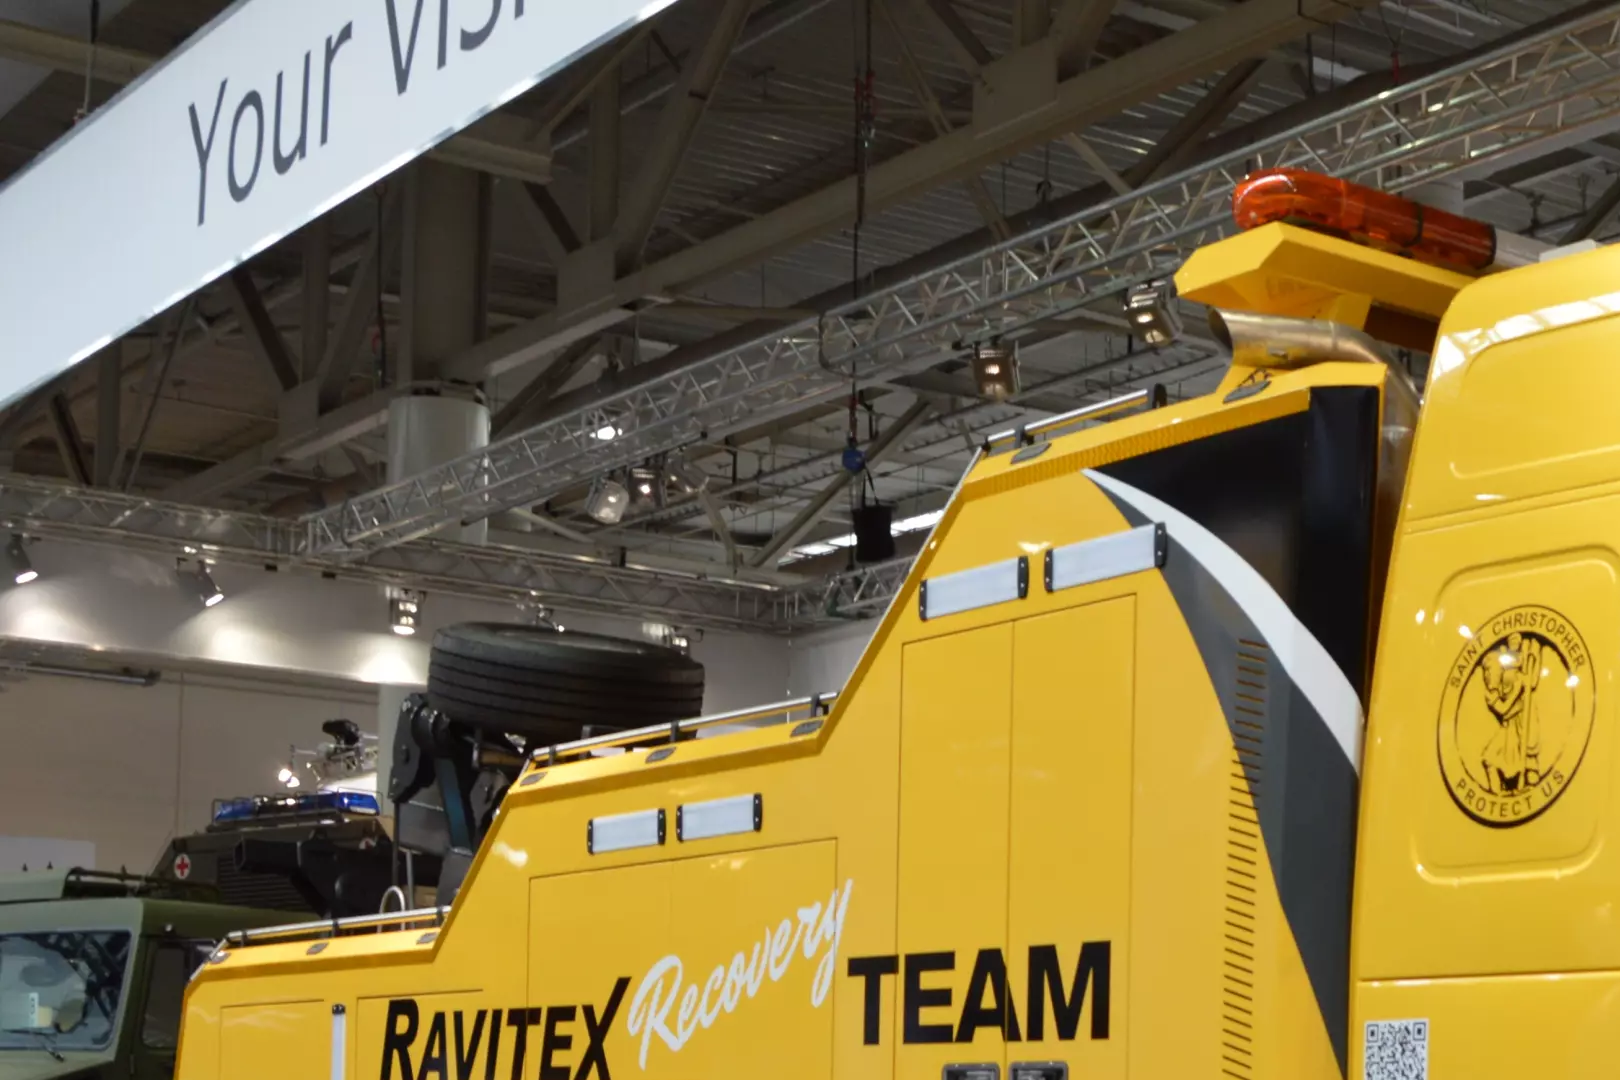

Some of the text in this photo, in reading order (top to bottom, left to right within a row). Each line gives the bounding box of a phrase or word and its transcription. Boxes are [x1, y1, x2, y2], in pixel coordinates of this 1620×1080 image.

[187, 20, 353, 228] Your
[1449, 611, 1586, 689] SAINT CHRISTOPHER
[1455, 770, 1565, 818] PROTECT US
[626, 878, 854, 1071] Recovery
[847, 940, 1112, 1046] TEAM
